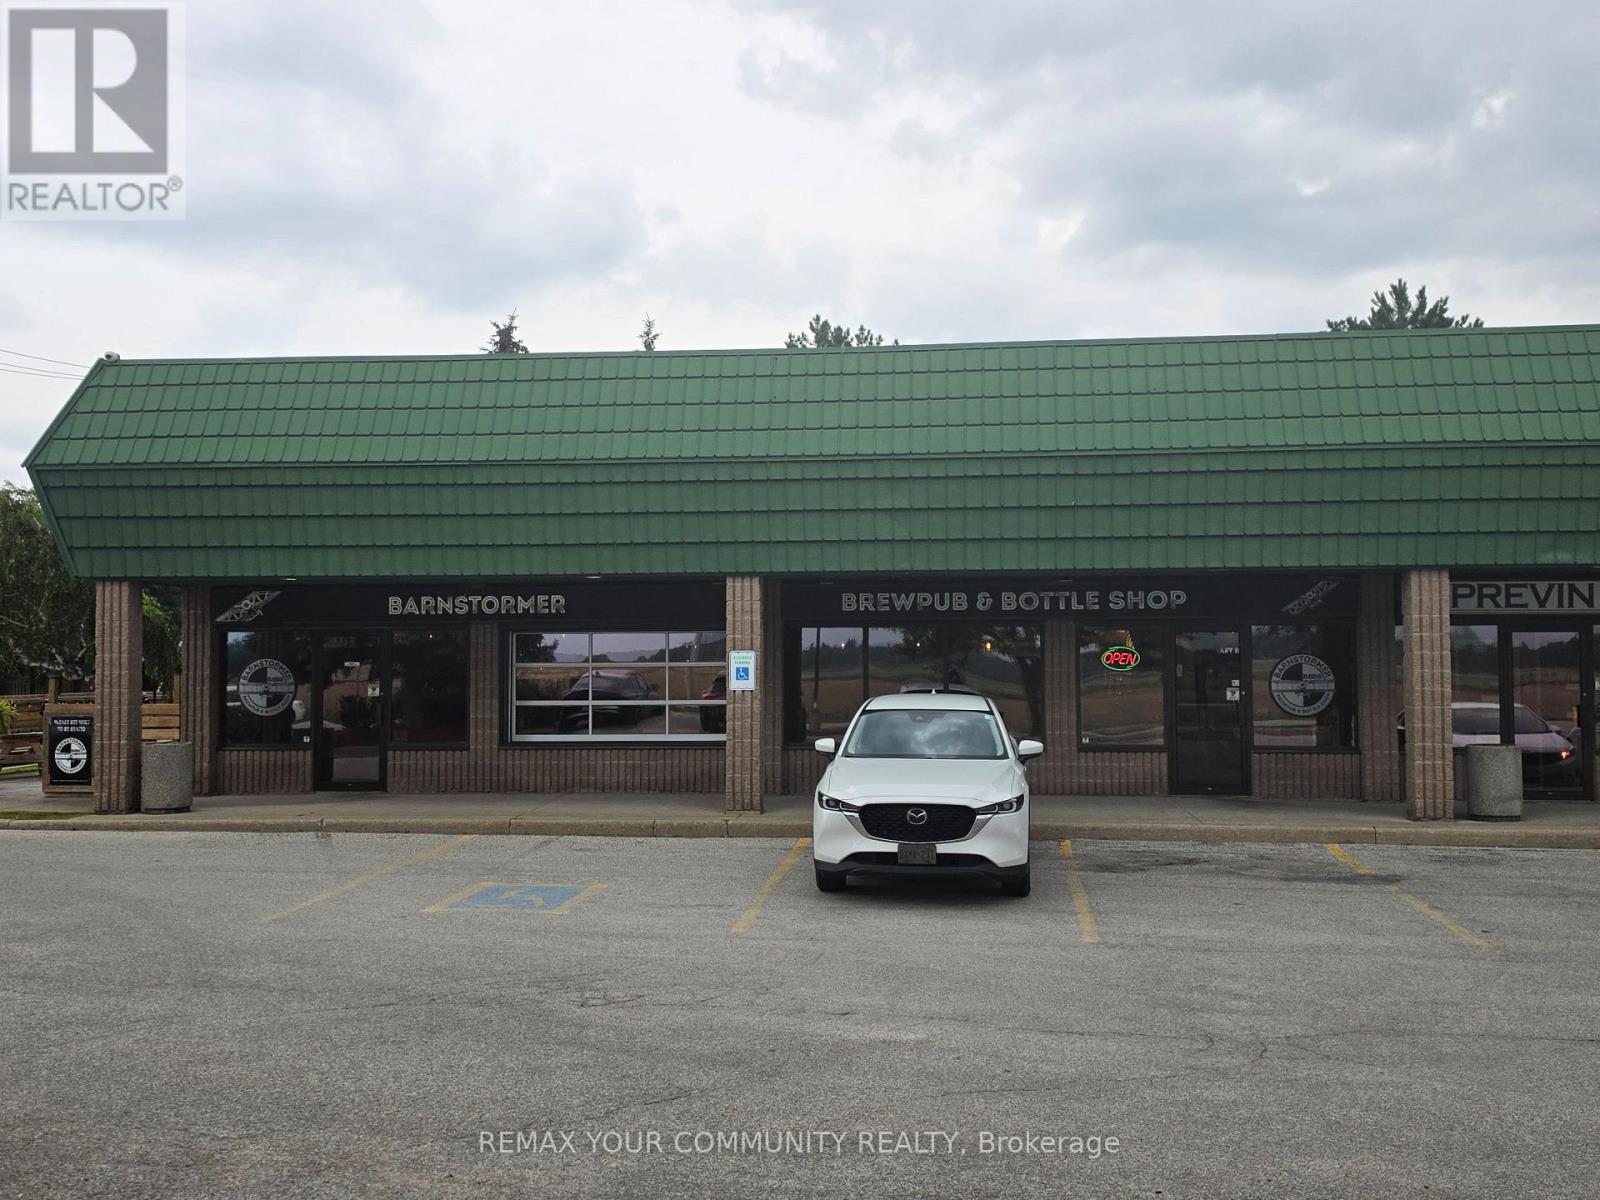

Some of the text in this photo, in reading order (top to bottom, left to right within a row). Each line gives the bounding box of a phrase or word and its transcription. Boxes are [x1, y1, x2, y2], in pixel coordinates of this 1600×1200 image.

[388, 595, 566, 615] BARNSTORMER
[841, 590, 1188, 611] BREWPUB & BOTTLE SHOP
[1452, 583, 1595, 609] PREVIN
[1103, 652, 1137, 665] OPEN
[1274, 655, 1332, 679] BARNSTORMER
[242, 660, 292, 681] BARNSTORMER
